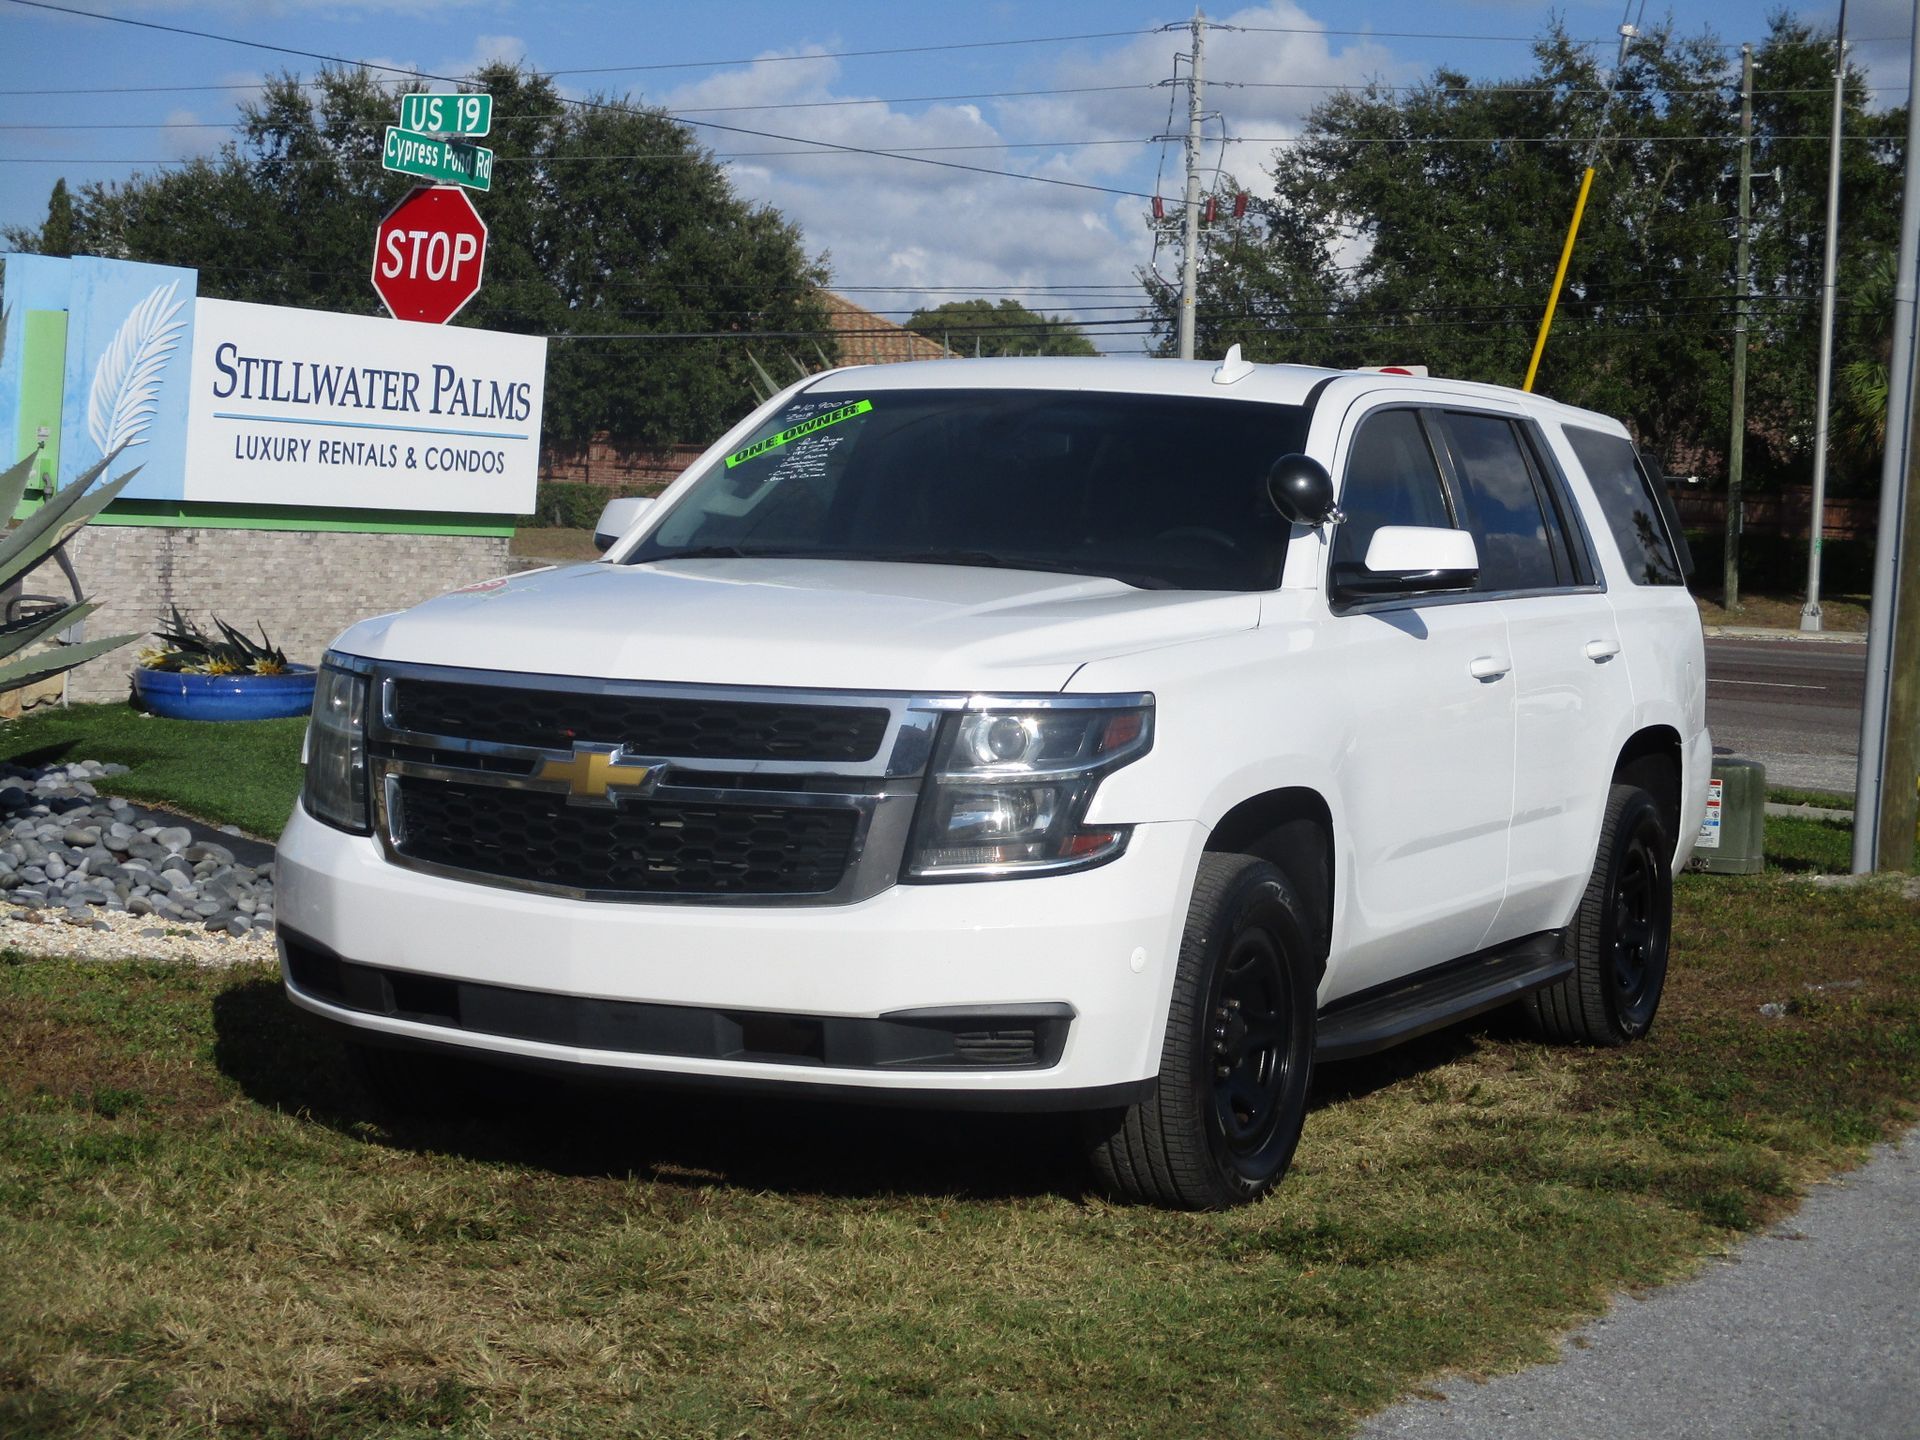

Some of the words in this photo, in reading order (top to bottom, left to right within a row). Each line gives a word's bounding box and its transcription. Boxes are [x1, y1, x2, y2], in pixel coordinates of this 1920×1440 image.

[410, 98, 443, 131] US
[456, 97, 480, 132] 19
[386, 130, 438, 167] Cypress
[443, 144, 472, 173] Pond
[476, 151, 490, 179] Rd
[381, 229, 477, 282] STOP
[213, 342, 420, 412] STILLWATER
[429, 364, 531, 421] PALMS
[235, 434, 311, 463] LUXURY
[318, 440, 397, 468] RENTALS
[405, 447, 417, 469] &
[425, 446, 505, 474] CONDOS
[735, 436, 777, 462] ONE
[782, 405, 858, 440] OWNER
